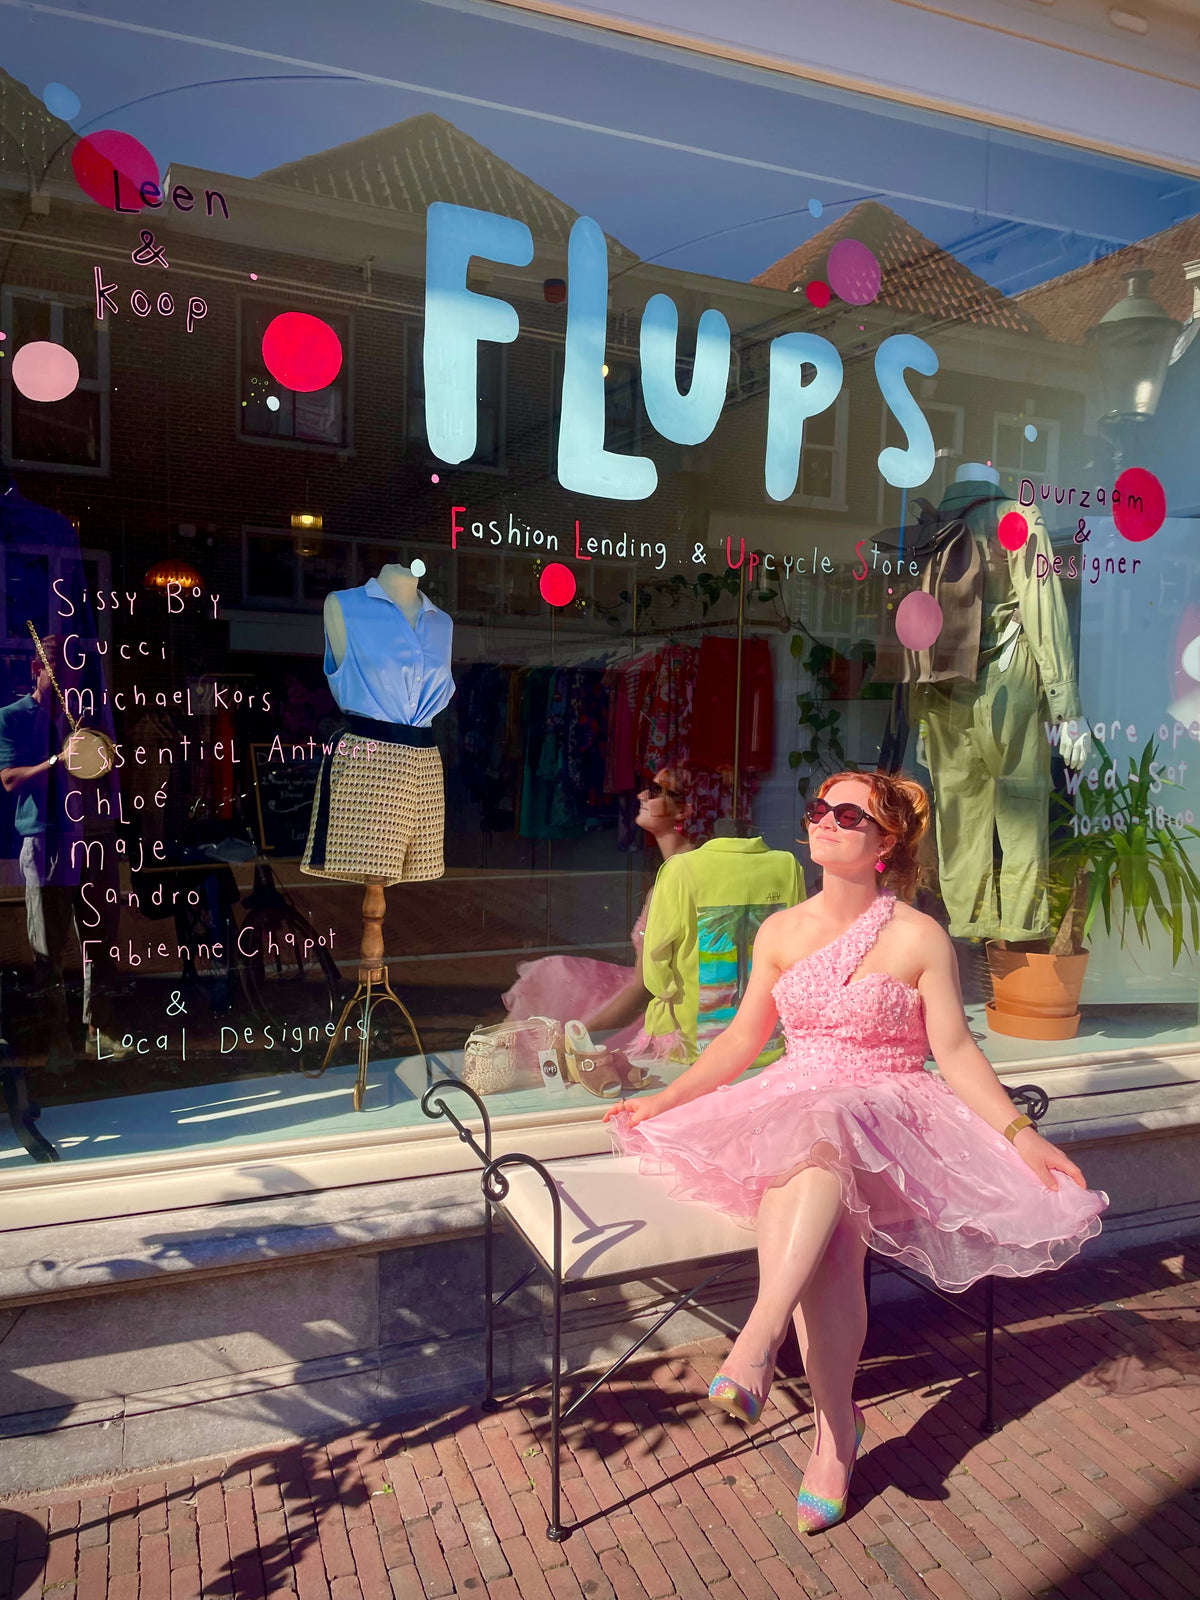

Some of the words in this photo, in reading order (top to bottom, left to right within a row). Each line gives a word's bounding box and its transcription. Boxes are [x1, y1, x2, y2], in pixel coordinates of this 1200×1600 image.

[112, 169, 230, 220] Leen
[131, 229, 169, 268] &
[423, 201, 939, 502] FLUPS
[1019, 478, 1144, 513] Duurzaam
[451, 506, 558, 551] Fashion
[575, 520, 667, 570] Lending
[691, 542, 707, 565] &
[726, 535, 834, 582] Upcycle
[852, 540, 920, 582] Store
[1073, 518, 1092, 544] &
[1036, 552, 1142, 584] Designer
[52, 578, 137, 617] Sissy
[166, 582, 220, 619] Boy
[63, 634, 166, 670] Gucci
[1094, 720, 1138, 743] are
[67, 734, 241, 771] Essentiel
[267, 734, 378, 764] Antwerp
[1148, 760, 1188, 794] Sat
[64, 781, 168, 825] Chloé
[80, 882, 201, 928] Sandro
[82, 939, 224, 980] Fabienne
[237, 926, 337, 962] Chapot
[165, 990, 188, 1017] &
[96, 1027, 187, 1061] Local
[220, 1018, 369, 1054] Designers
